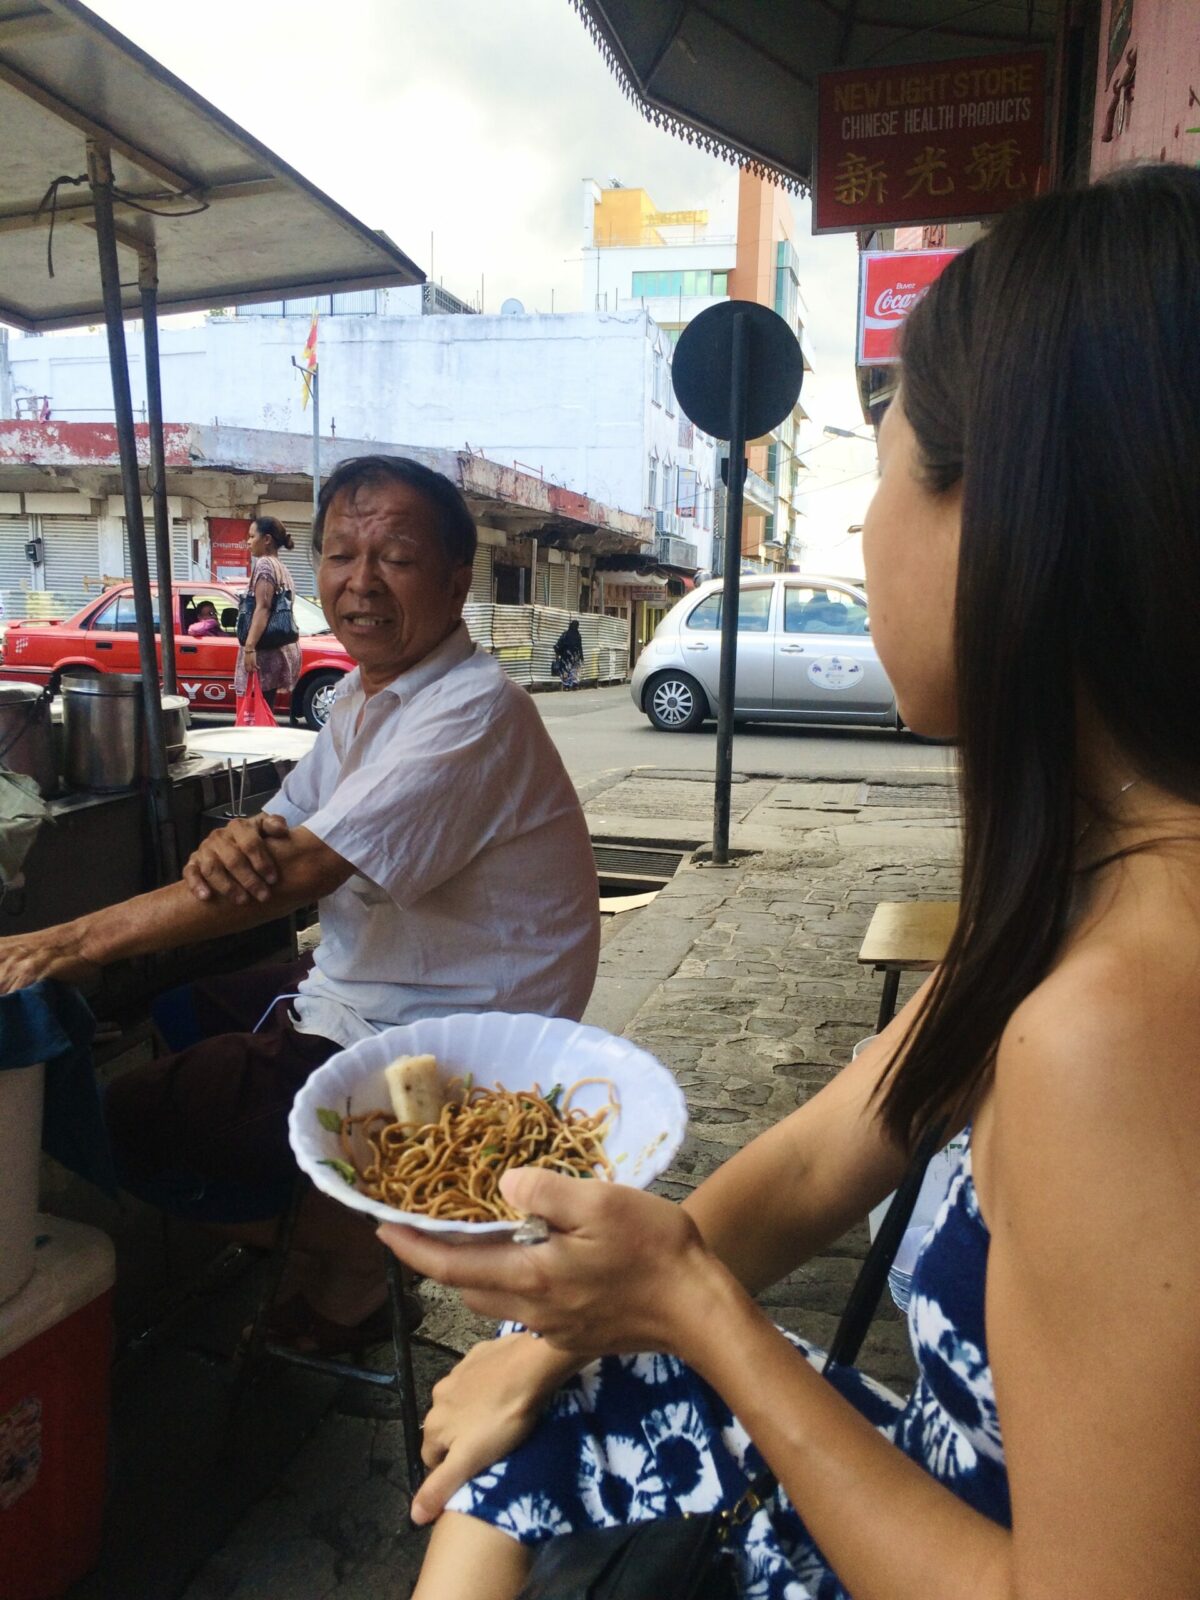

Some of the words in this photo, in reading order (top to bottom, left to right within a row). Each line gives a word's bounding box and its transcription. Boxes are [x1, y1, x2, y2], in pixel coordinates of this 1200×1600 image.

[834, 82, 881, 112] NEW
[887, 74, 950, 106] LIGHT
[954, 65, 1032, 98] STORE
[841, 110, 899, 141] CHINESE
[904, 105, 954, 134] HEALTH
[958, 97, 1031, 128] PRODUCTS
